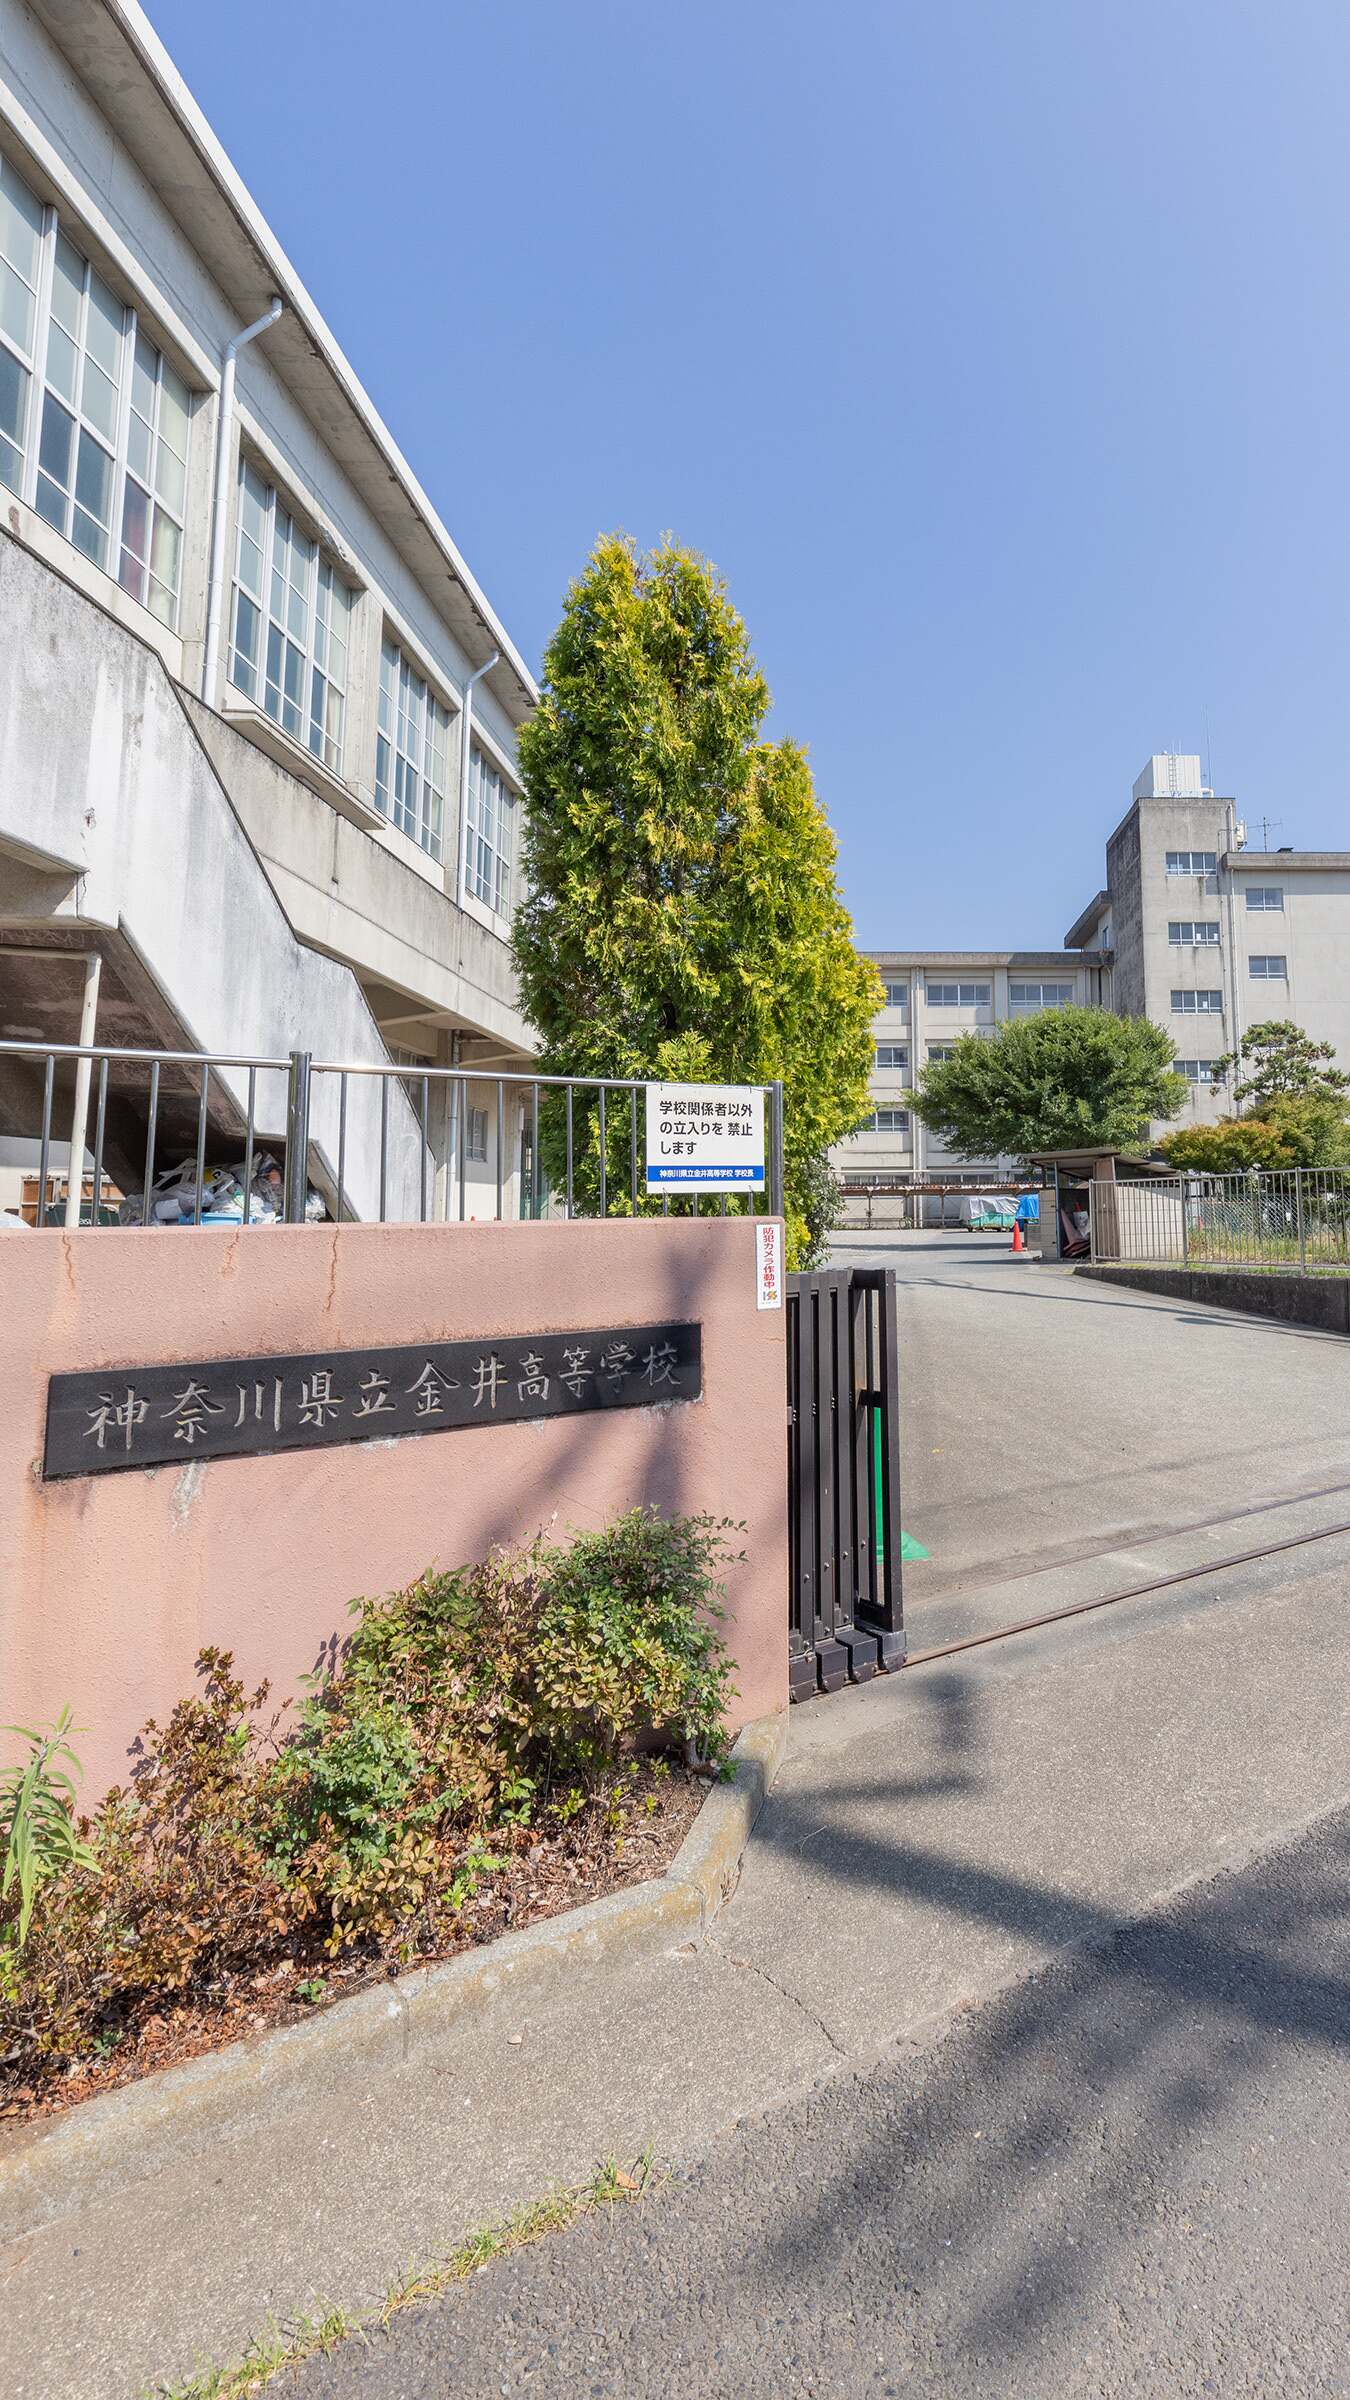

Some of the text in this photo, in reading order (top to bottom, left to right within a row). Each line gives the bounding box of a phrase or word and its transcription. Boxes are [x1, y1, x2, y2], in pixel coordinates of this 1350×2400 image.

[659, 1101, 753, 1118] 学校関係者以外
[660, 1121, 753, 1137] の立入りを 禁止
[661, 1141, 697, 1155] します
[762, 1227, 776, 1289] 防犯カメラ作動中
[83, 1340, 683, 1451] 神奈川県立金井高等学校
